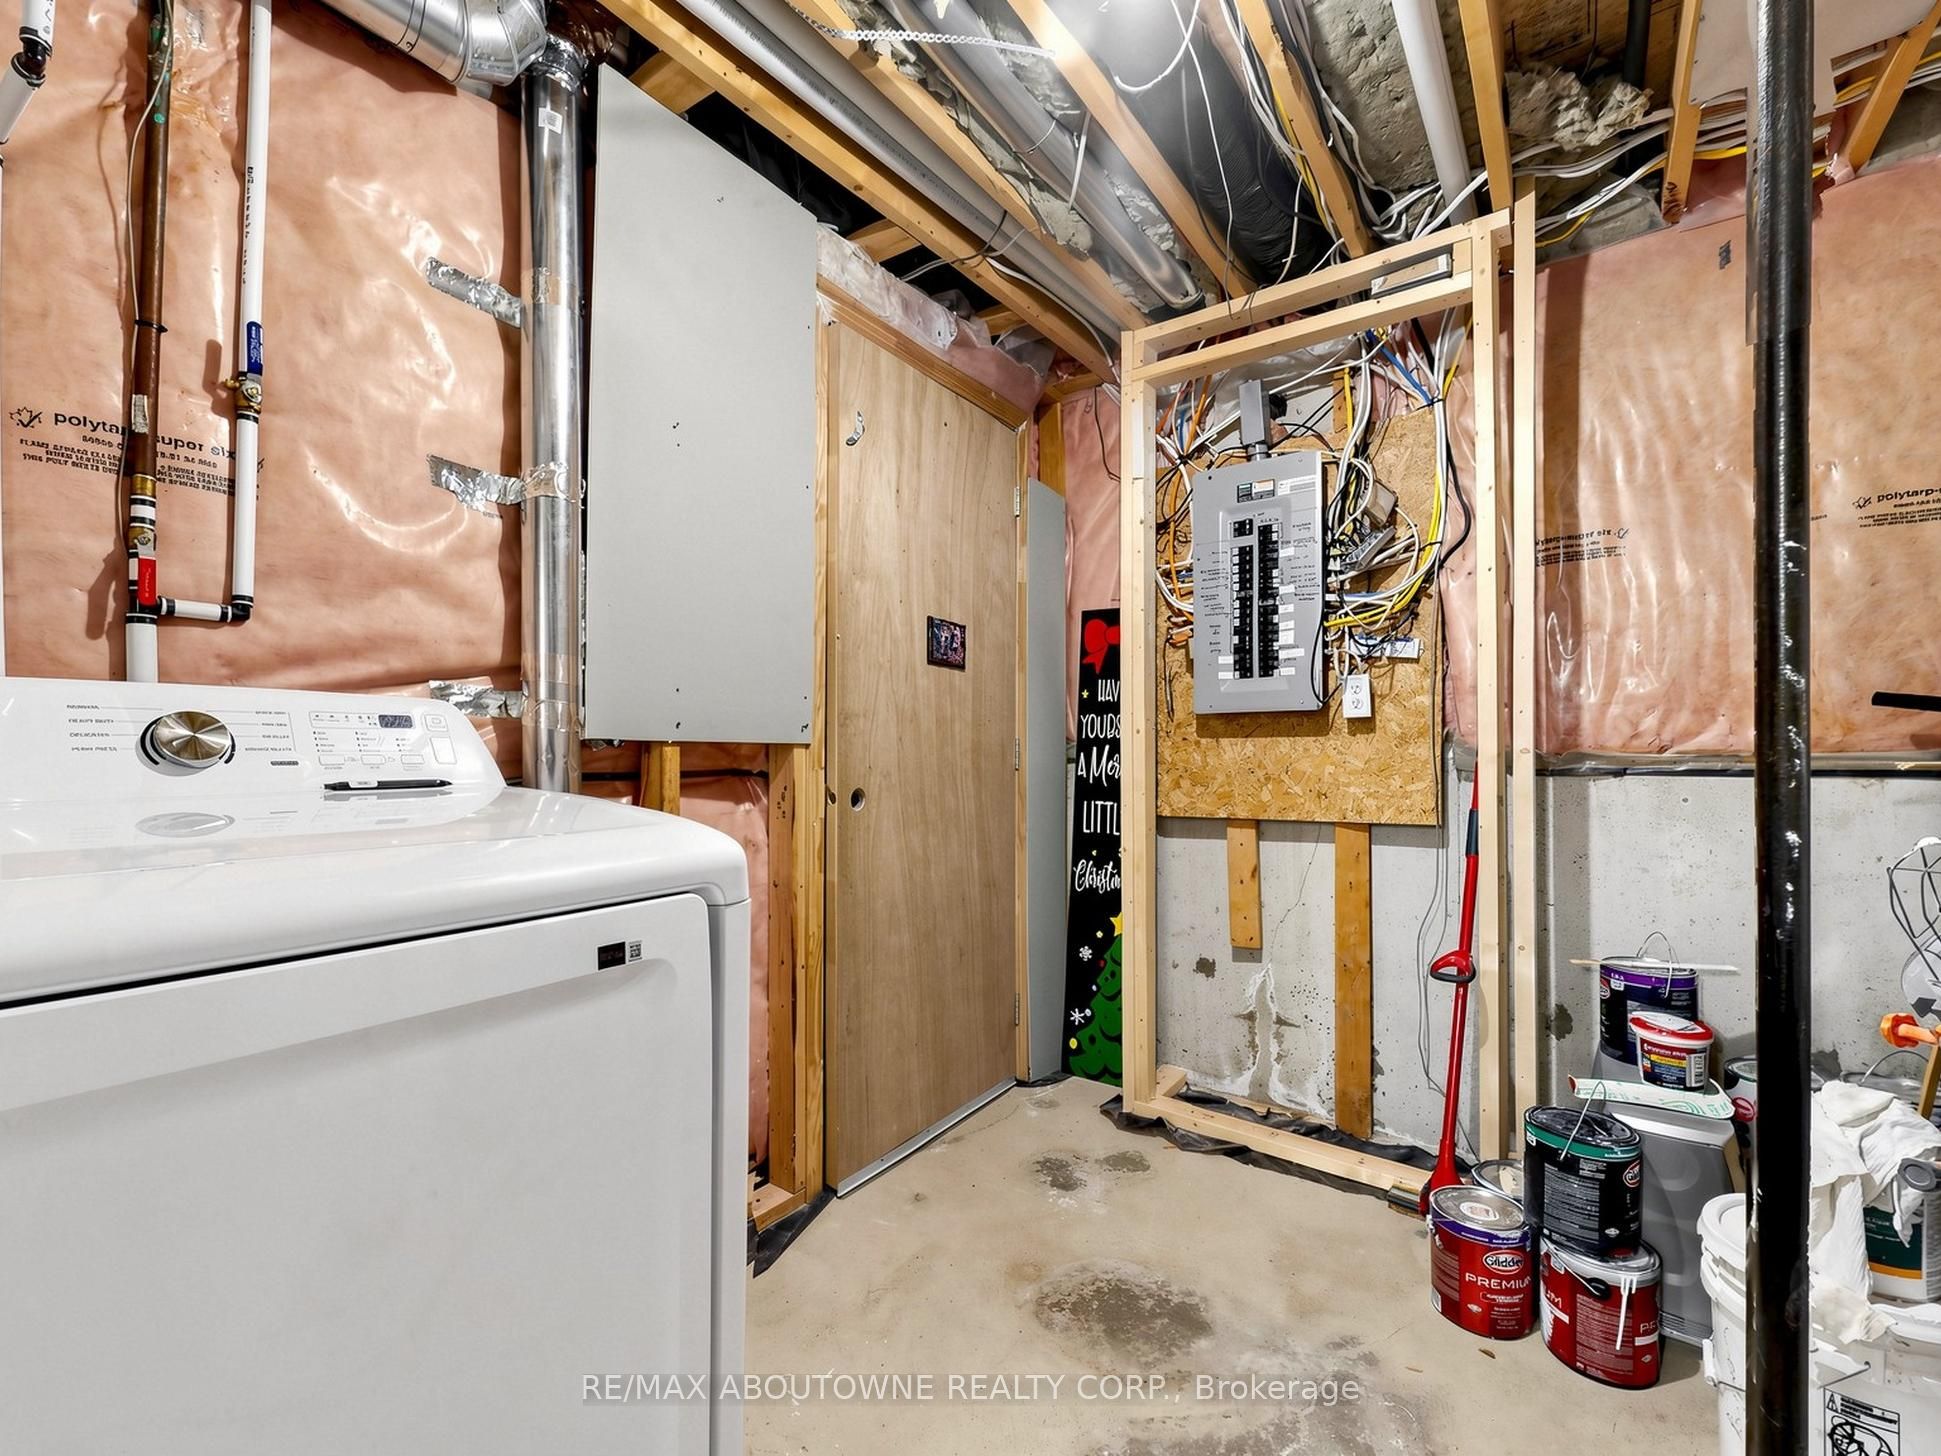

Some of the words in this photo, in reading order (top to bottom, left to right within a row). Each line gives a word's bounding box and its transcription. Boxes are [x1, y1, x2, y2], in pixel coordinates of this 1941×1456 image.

[1097, 679, 1120, 702] HAV
[1080, 713, 1120, 739] YOURS
[1077, 751, 1087, 778] A
[1089, 744, 1120, 787] Mer
[1082, 800, 1120, 835] LITTL
